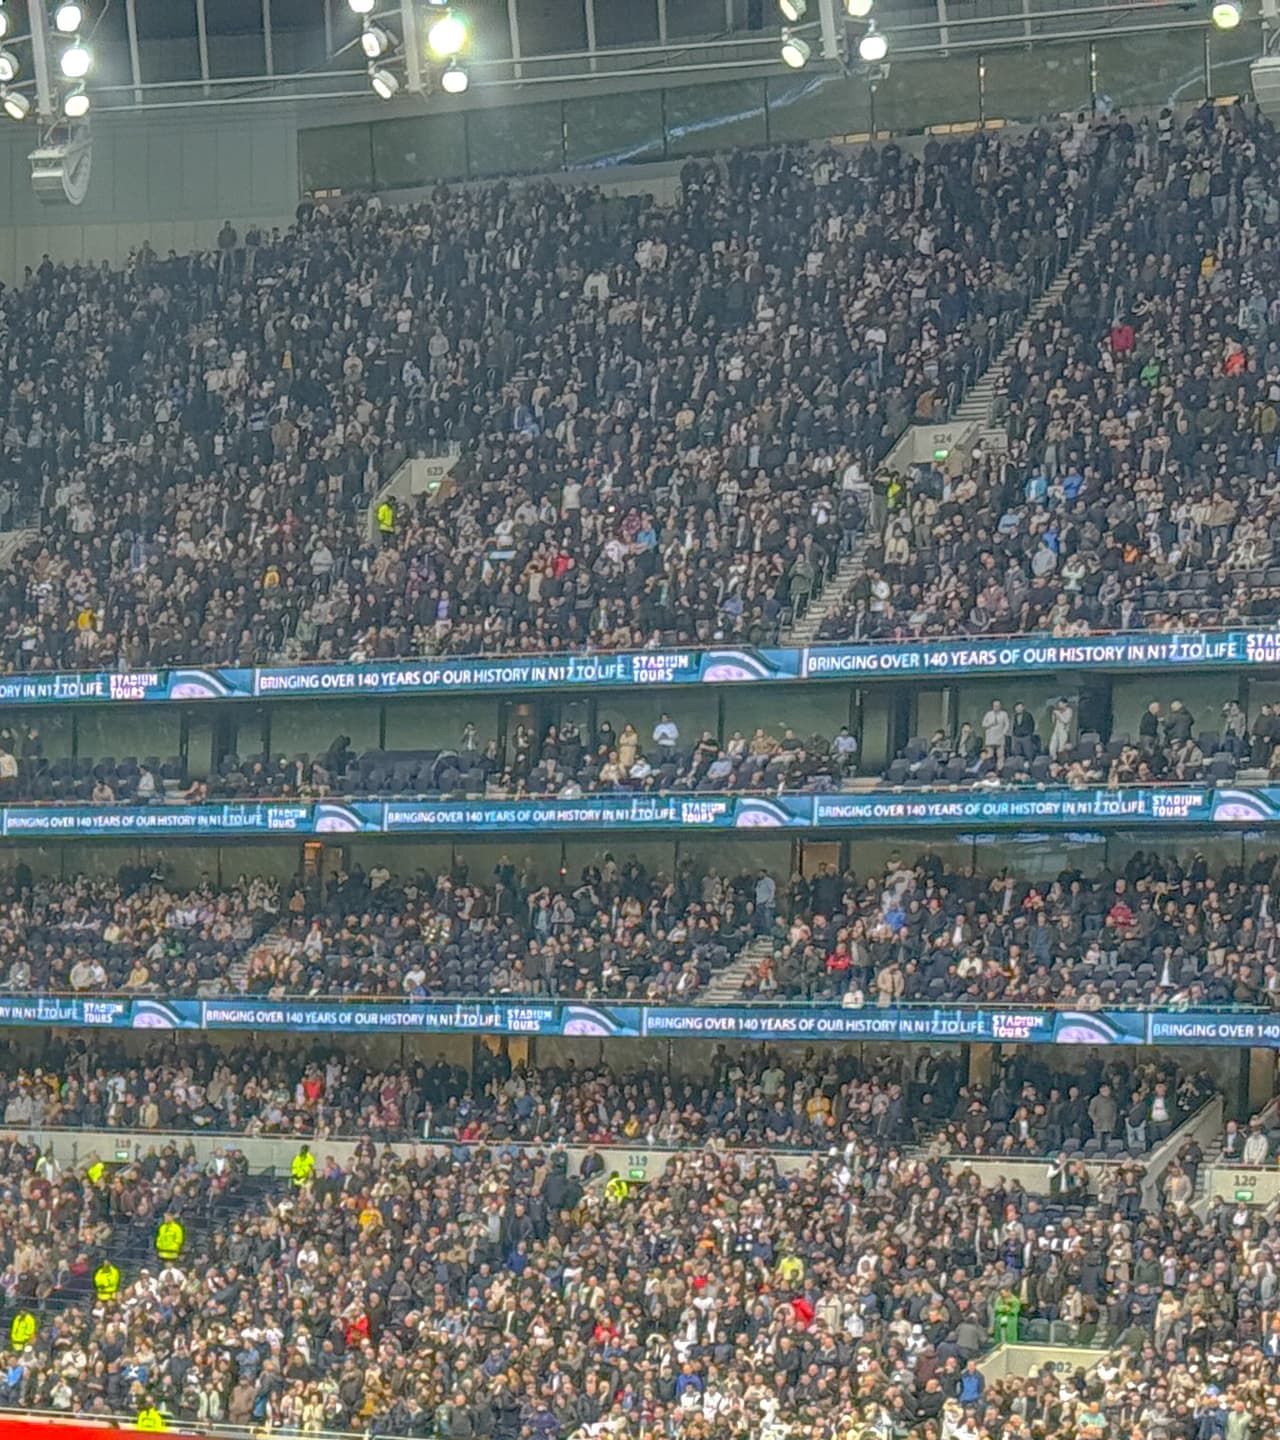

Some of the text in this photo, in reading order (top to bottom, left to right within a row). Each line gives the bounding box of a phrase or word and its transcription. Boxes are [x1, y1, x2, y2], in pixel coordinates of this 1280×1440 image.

[809, 643, 1235, 670] BRINGING OVER 140 YEARS OF OUR HISTORY IN N17 TO LIFE
[260, 664, 623, 689] BRINGING OVER 140 YEARS OF OUR HISTORY IN N17 TO LIFE
[819, 806, 871, 817] BRINGING
[874, 804, 904, 816] OVER
[907, 805, 925, 815] 140
[929, 804, 962, 815] YEARS
[965, 804, 980, 814] OF
[983, 804, 1008, 814] OUR
[1011, 803, 1059, 813] HISTORY
[1063, 803, 1075, 814] IN
[1103, 801, 1120, 813] TO
[1121, 800, 1144, 813] LIFE
[648, 1017, 702, 1029] BRINGING
[705, 1018, 735, 1029] OVER
[739, 1019, 758, 1029] 140
[761, 1018, 796, 1031] YEARS
[799, 1019, 814, 1030] OF
[817, 1019, 843, 1031] OUR
[846, 1020, 896, 1032] HISTORY
[900, 1021, 912, 1031] IN
[942, 1021, 959, 1033] TO
[960, 1022, 984, 1034] LIFE
[1153, 1024, 1215, 1036] BRINGING
[1219, 1025, 1253, 1038] OVER
[1233, 1175, 1257, 1187] 120
